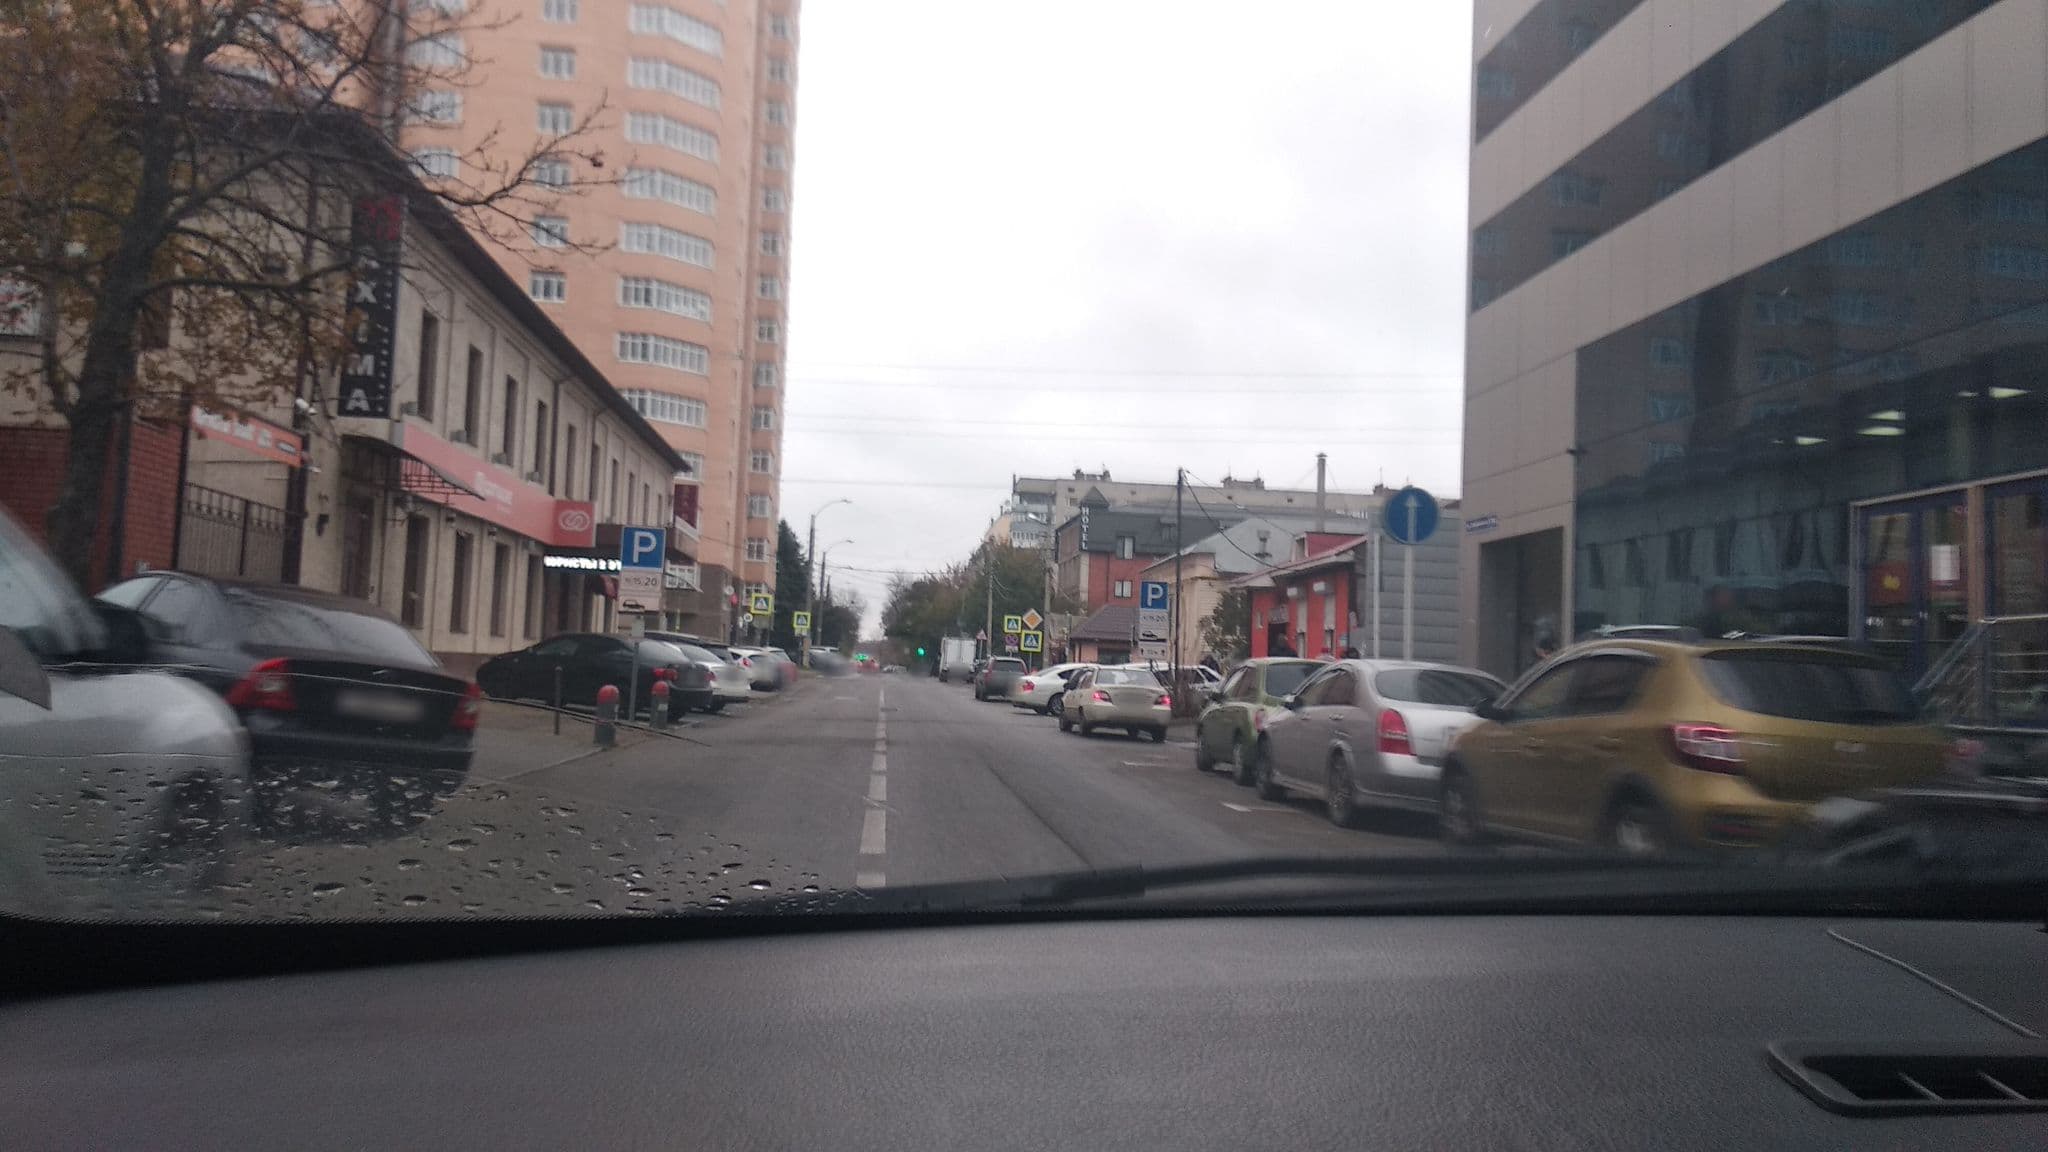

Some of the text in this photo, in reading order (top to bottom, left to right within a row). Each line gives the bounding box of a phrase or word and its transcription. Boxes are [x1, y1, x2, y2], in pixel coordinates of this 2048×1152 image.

[1081, 506, 1090, 550] HOTEL
[632, 531, 657, 563] P
[1147, 583, 1164, 607] P
